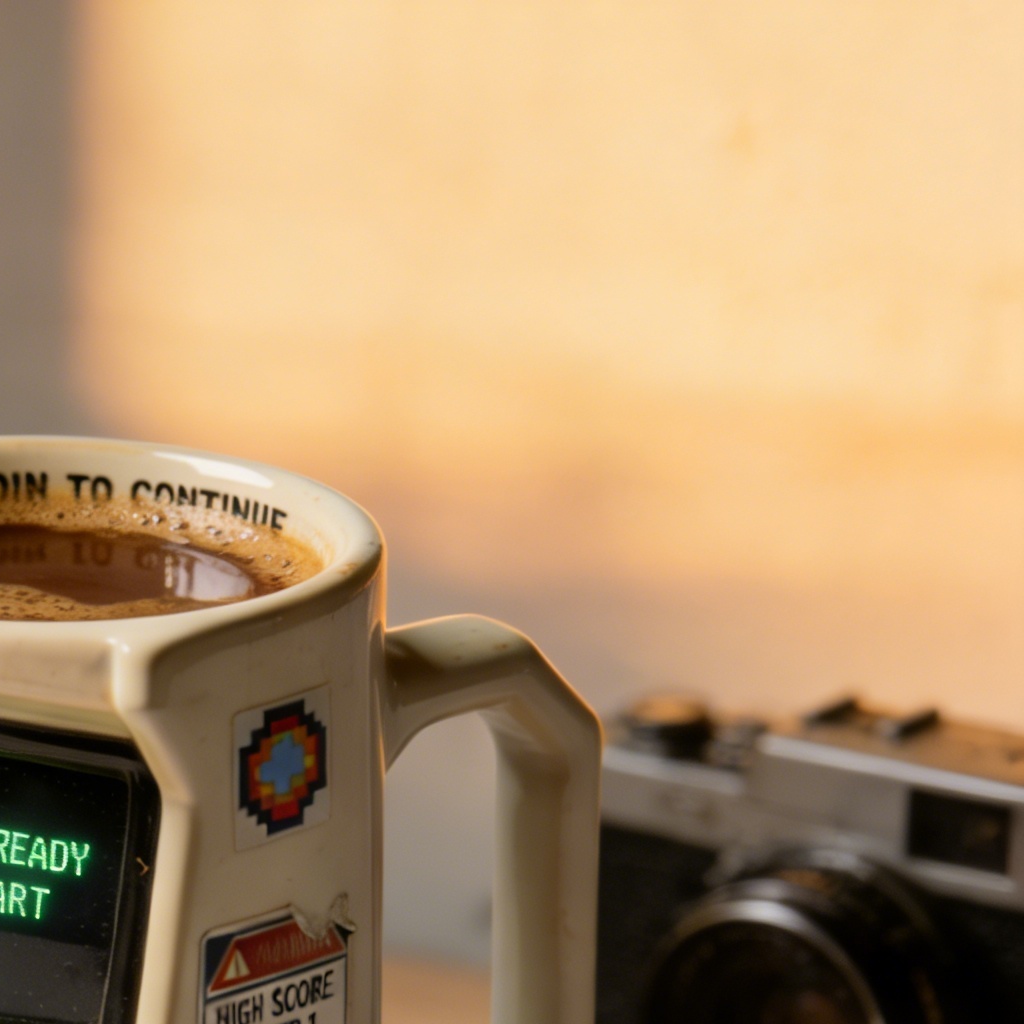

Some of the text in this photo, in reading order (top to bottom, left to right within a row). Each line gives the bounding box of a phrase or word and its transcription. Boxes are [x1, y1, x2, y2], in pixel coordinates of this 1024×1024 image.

[67, 474, 113, 502] TO
[131, 480, 288, 530] CONTINUE
[272, 969, 335, 1017] SCORE
